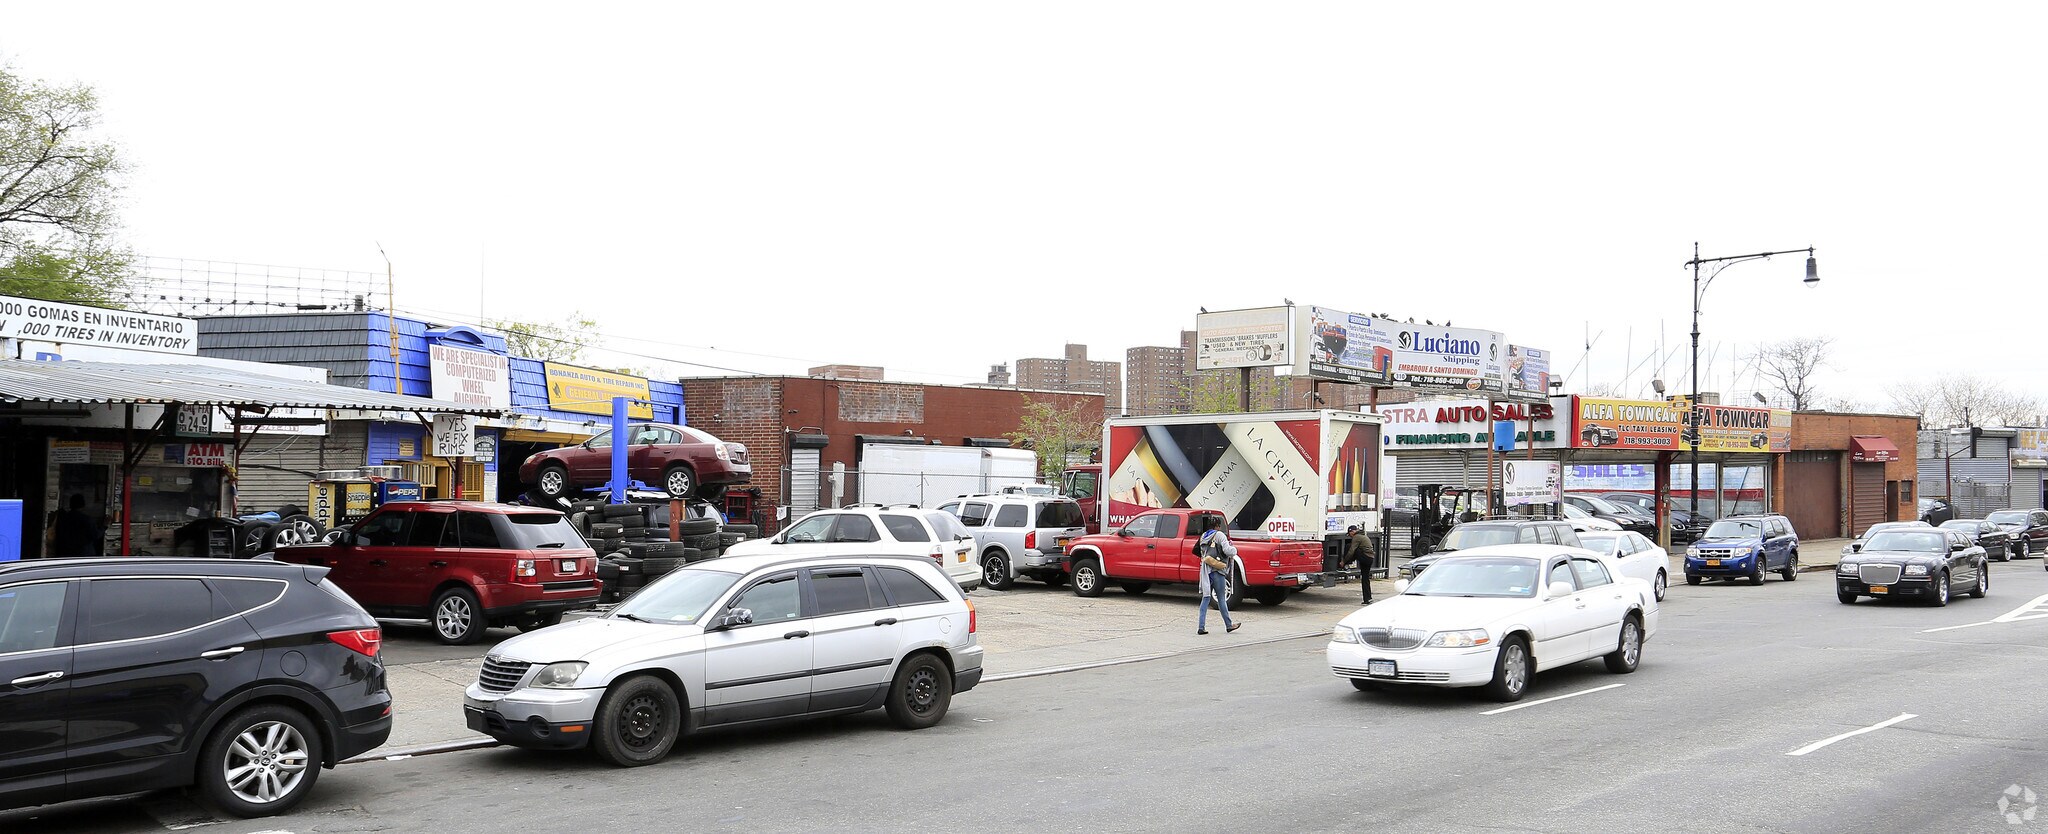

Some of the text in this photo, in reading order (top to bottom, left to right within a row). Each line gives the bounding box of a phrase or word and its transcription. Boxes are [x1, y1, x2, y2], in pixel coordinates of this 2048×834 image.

[0, 302, 183, 334] 00 GOMAS EN INVENTARIO
[55, 325, 95, 341] TIRES
[98, 330, 114, 343] IN
[116, 332, 190, 350] INVENTORY
[1204, 336, 1236, 344] TRANSMISSIONS
[1235, 340, 1247, 348] NEW
[1250, 339, 1265, 347] TIRES
[1413, 331, 1480, 356] Luciano
[432, 346, 506, 370] WE ARE SPECIALIST IN
[1443, 355, 1480, 367] Shipping
[445, 362, 497, 382] COMPUTERIZED
[1398, 363, 1429, 374] EMBARQUE
[1429, 366, 1434, 374] A
[1433, 366, 1451, 376] SANTO
[1452, 368, 1478, 376] DOMINGO
[461, 378, 485, 394] WHEEL
[549, 368, 580, 382] BONANZA
[580, 373, 596, 384] AUTO
[603, 377, 615, 387] TIRE
[615, 379, 635, 390] REPAIR
[635, 382, 645, 391] INC
[454, 391, 492, 406] ALIGNMENT
[569, 388, 600, 401] GENERAL
[1380, 402, 1555, 424] STRA AUTO SALES
[1582, 403, 1678, 424] ALFA TOWNCAR
[1681, 407, 1769, 430] AFA TOWNCAR
[188, 416, 199, 431] 24
[448, 417, 467, 432] YES
[1618, 424, 1678, 434] TLC TAXI LEASING
[436, 432, 469, 446] WE FIX
[1395, 433, 1471, 445] FINANCING
[1474, 430, 1556, 445] AVABLE
[1624, 436, 1671, 446] 718-993-3003
[187, 443, 225, 457] ATM
[439, 443, 465, 455] RIMS
[1285, 429, 1313, 462] www.lacrema.com
[187, 458, 226, 467] $10. Bills
[1246, 427, 1311, 507] LA CREMA
[1197, 461, 1238, 507] LA CREMA
[347, 492, 371, 504] Snapple
[397, 488, 419, 496] PEPSI
[1268, 521, 1295, 532] OPEN
